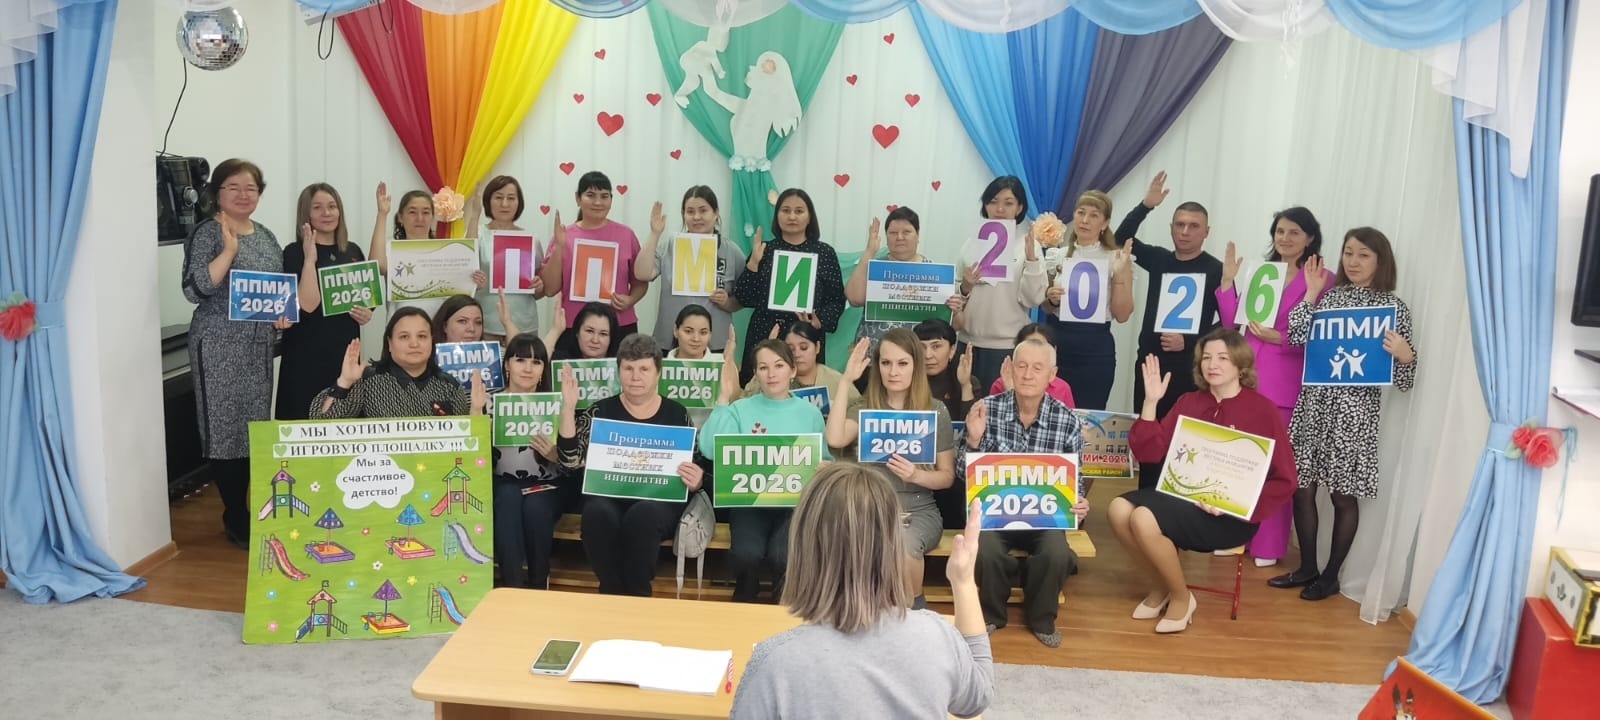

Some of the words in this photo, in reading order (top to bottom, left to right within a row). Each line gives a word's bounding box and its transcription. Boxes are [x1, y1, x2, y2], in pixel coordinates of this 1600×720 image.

[978, 221, 1008, 278] 2
[493, 235, 533, 289] П
[674, 237, 716, 293] М
[323, 268, 374, 289] ППМИ
[574, 243, 616, 300] П
[883, 270, 940, 282] Программа
[235, 278, 291, 295] ППМИ
[773, 255, 813, 308] И
[1068, 261, 1100, 320] 0
[331, 287, 372, 306] 2026
[1161, 275, 1197, 330] 2
[1245, 263, 1279, 324] 6
[240, 298, 285, 314] 2026
[1310, 315, 1391, 341] ППМИ
[438, 348, 495, 367] ППМИ
[661, 366, 719, 381] ППМИ
[577, 385, 610, 400] 026
[667, 385, 712, 399] 2026
[498, 401, 560, 417] ППМИ
[300, 426, 328, 438] МЫ
[335, 423, 390, 435] ХОТИМ
[396, 420, 453, 433] НОВУЮ
[504, 421, 554, 437] 2026
[864, 418, 929, 434] ППМИ
[290, 442, 367, 456] ИГРОВУЮ
[371, 441, 446, 453] ПЛОЩАДКУ
[609, 431, 675, 448] Программа
[870, 438, 922, 455] 2026
[356, 457, 377, 467] Мы
[379, 458, 391, 467] за
[722, 445, 812, 466] ППМИ
[342, 472, 406, 483] счастливое
[604, 473, 669, 486] инициатив
[731, 473, 802, 493] 2026
[975, 465, 1068, 486] ППМИ
[351, 487, 398, 500] детство!
[985, 493, 1058, 516] 2026
